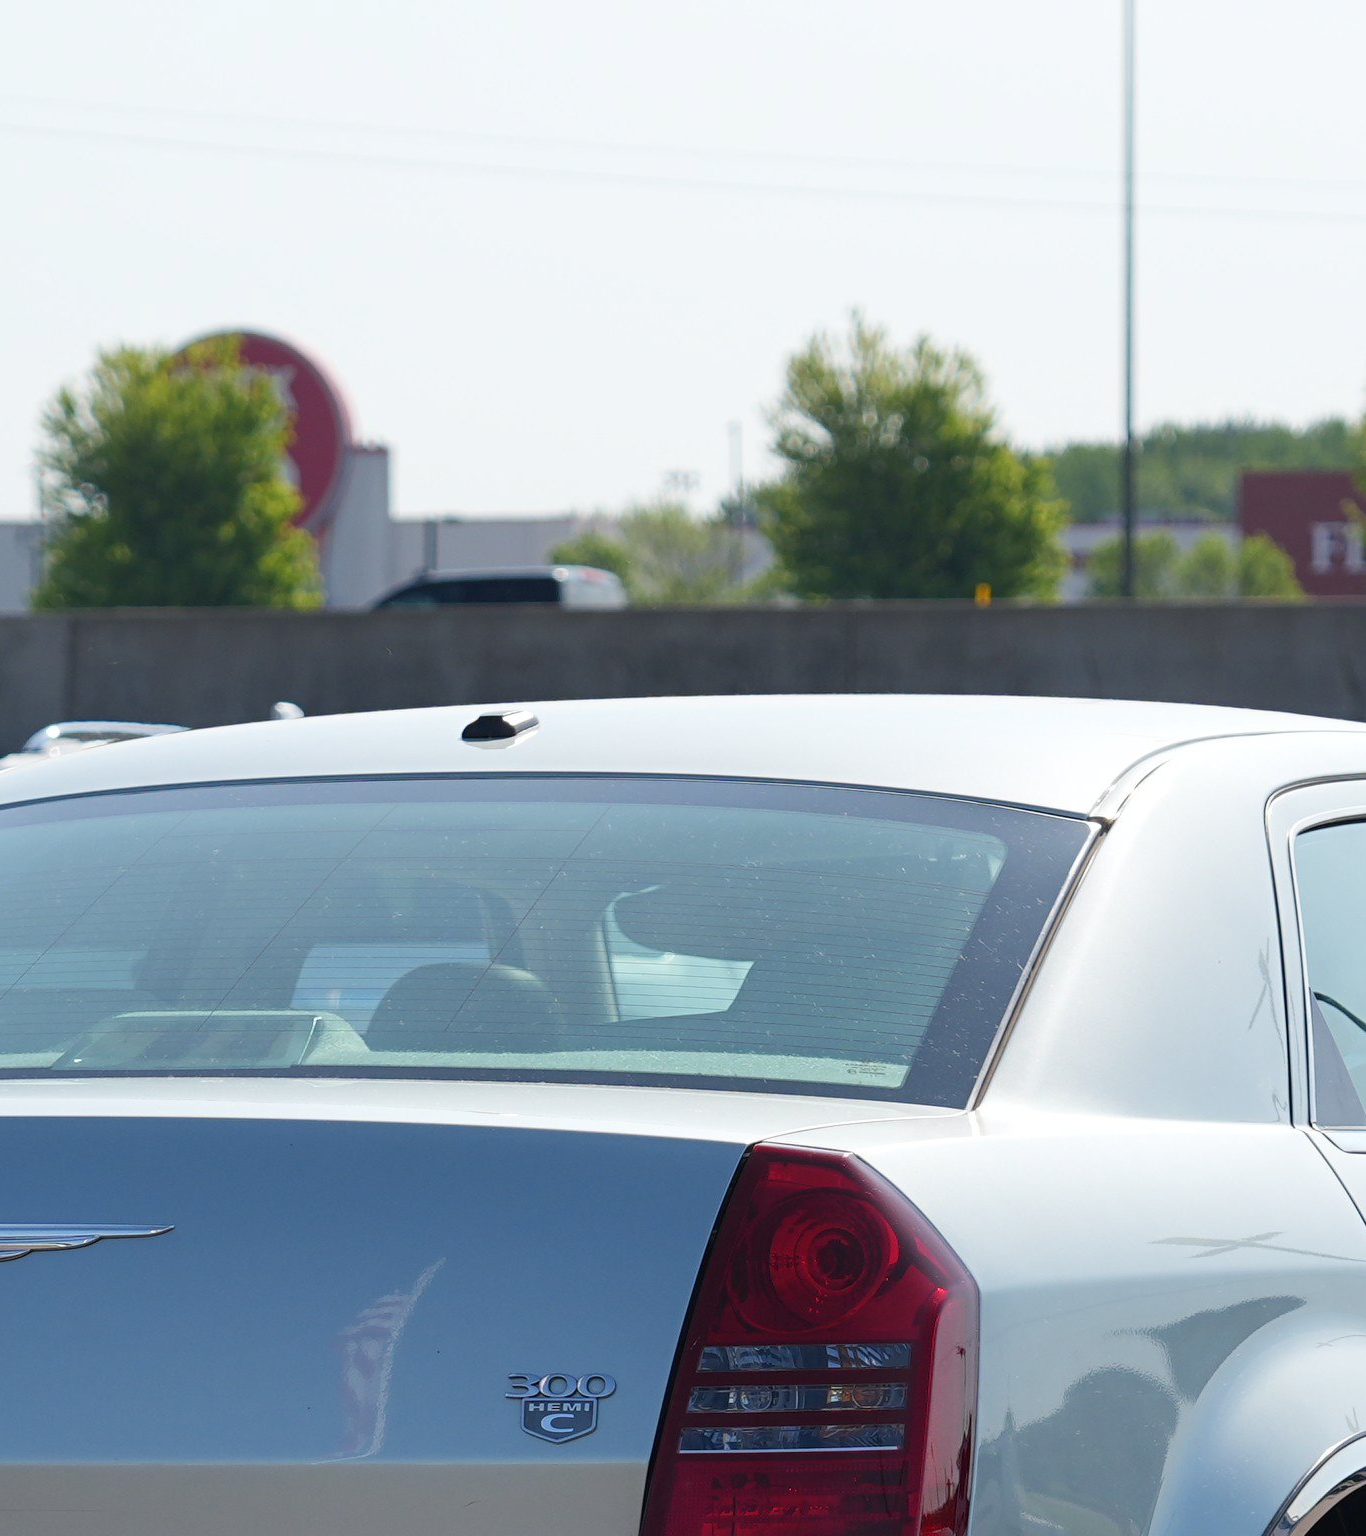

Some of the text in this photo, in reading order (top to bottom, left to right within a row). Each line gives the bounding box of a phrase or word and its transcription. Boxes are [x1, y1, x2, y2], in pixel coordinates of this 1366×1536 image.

[505, 1372, 617, 1399] 300
[528, 1402, 590, 1412] HEMI
[540, 1413, 575, 1433] C
